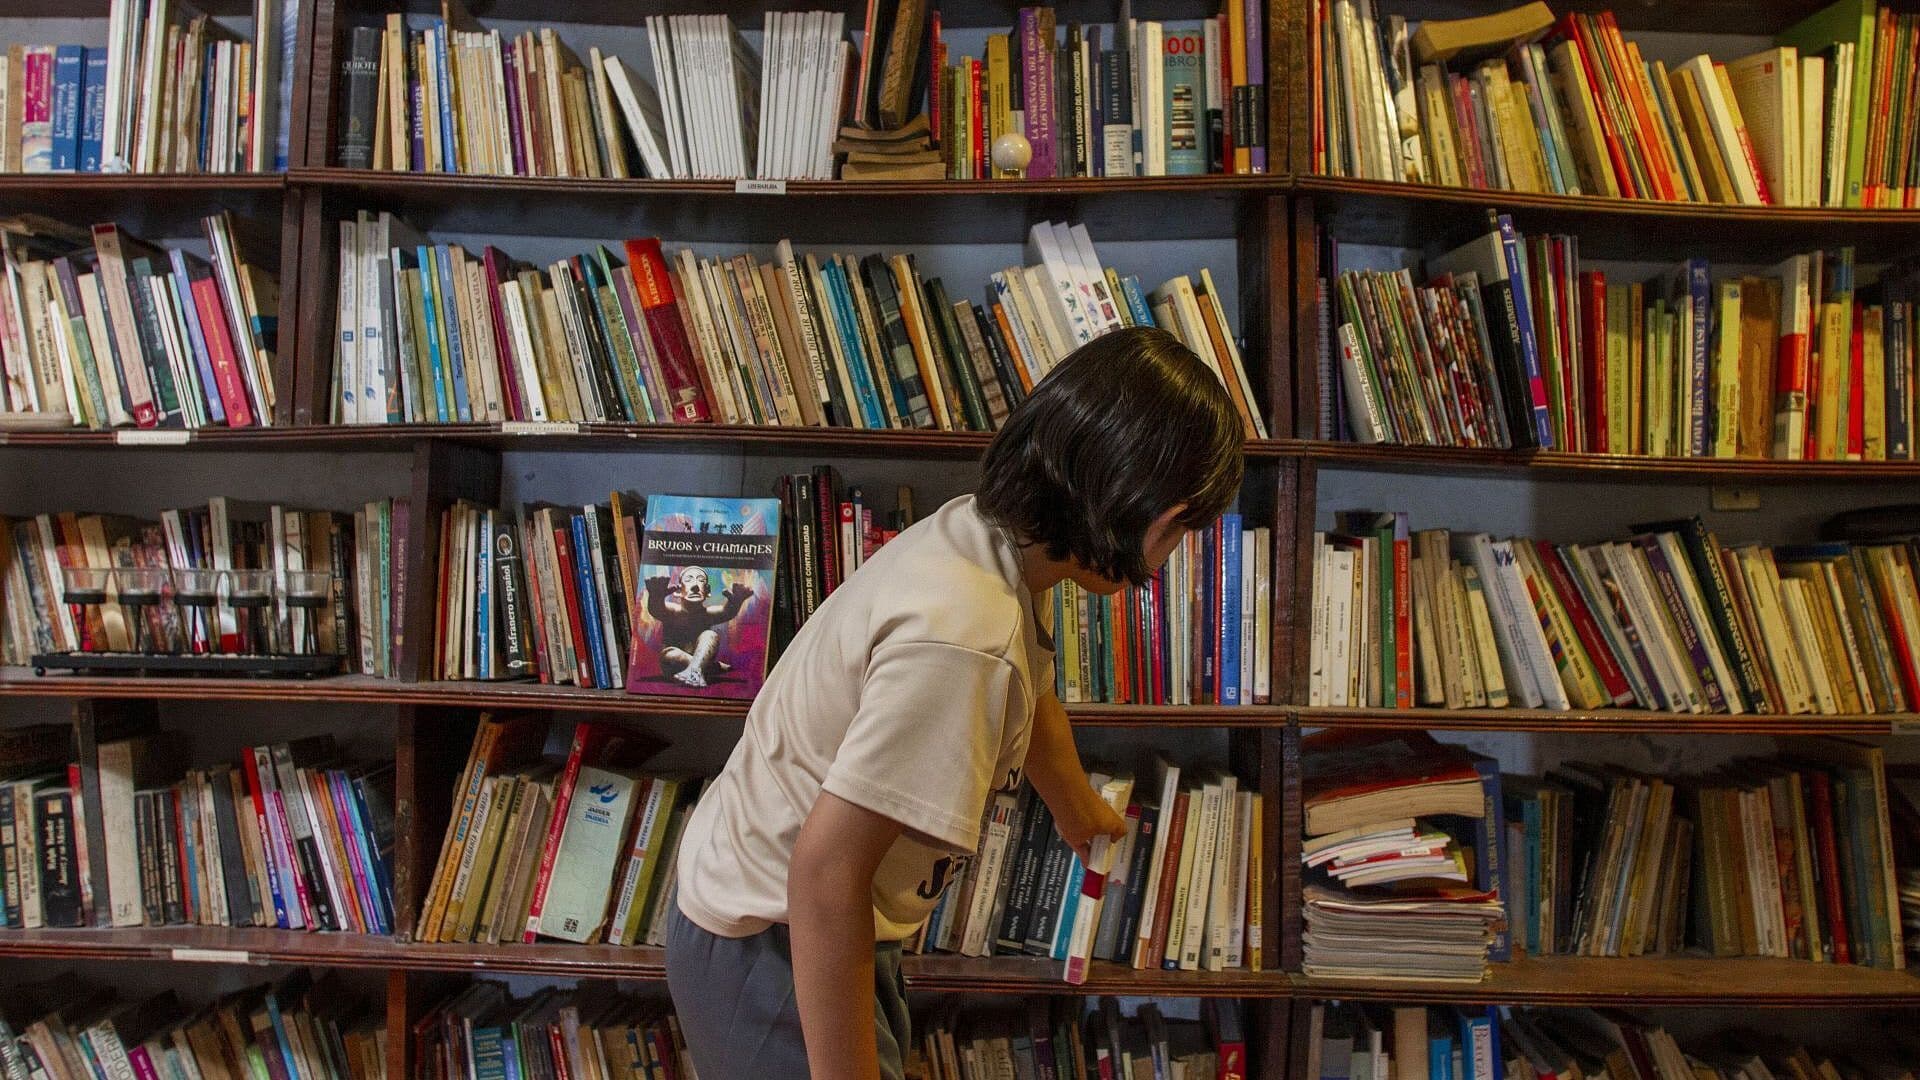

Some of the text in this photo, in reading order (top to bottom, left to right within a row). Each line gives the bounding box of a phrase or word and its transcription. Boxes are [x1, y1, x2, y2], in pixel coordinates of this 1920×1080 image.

[785, 257, 808, 316] PSICODRAMA
[648, 539, 693, 552] BRUJOS
[702, 542, 773, 555] CHAMANES
[801, 524, 815, 614] CURSO DE CONTABILIDAD
[501, 564, 519, 653] Refranero español
